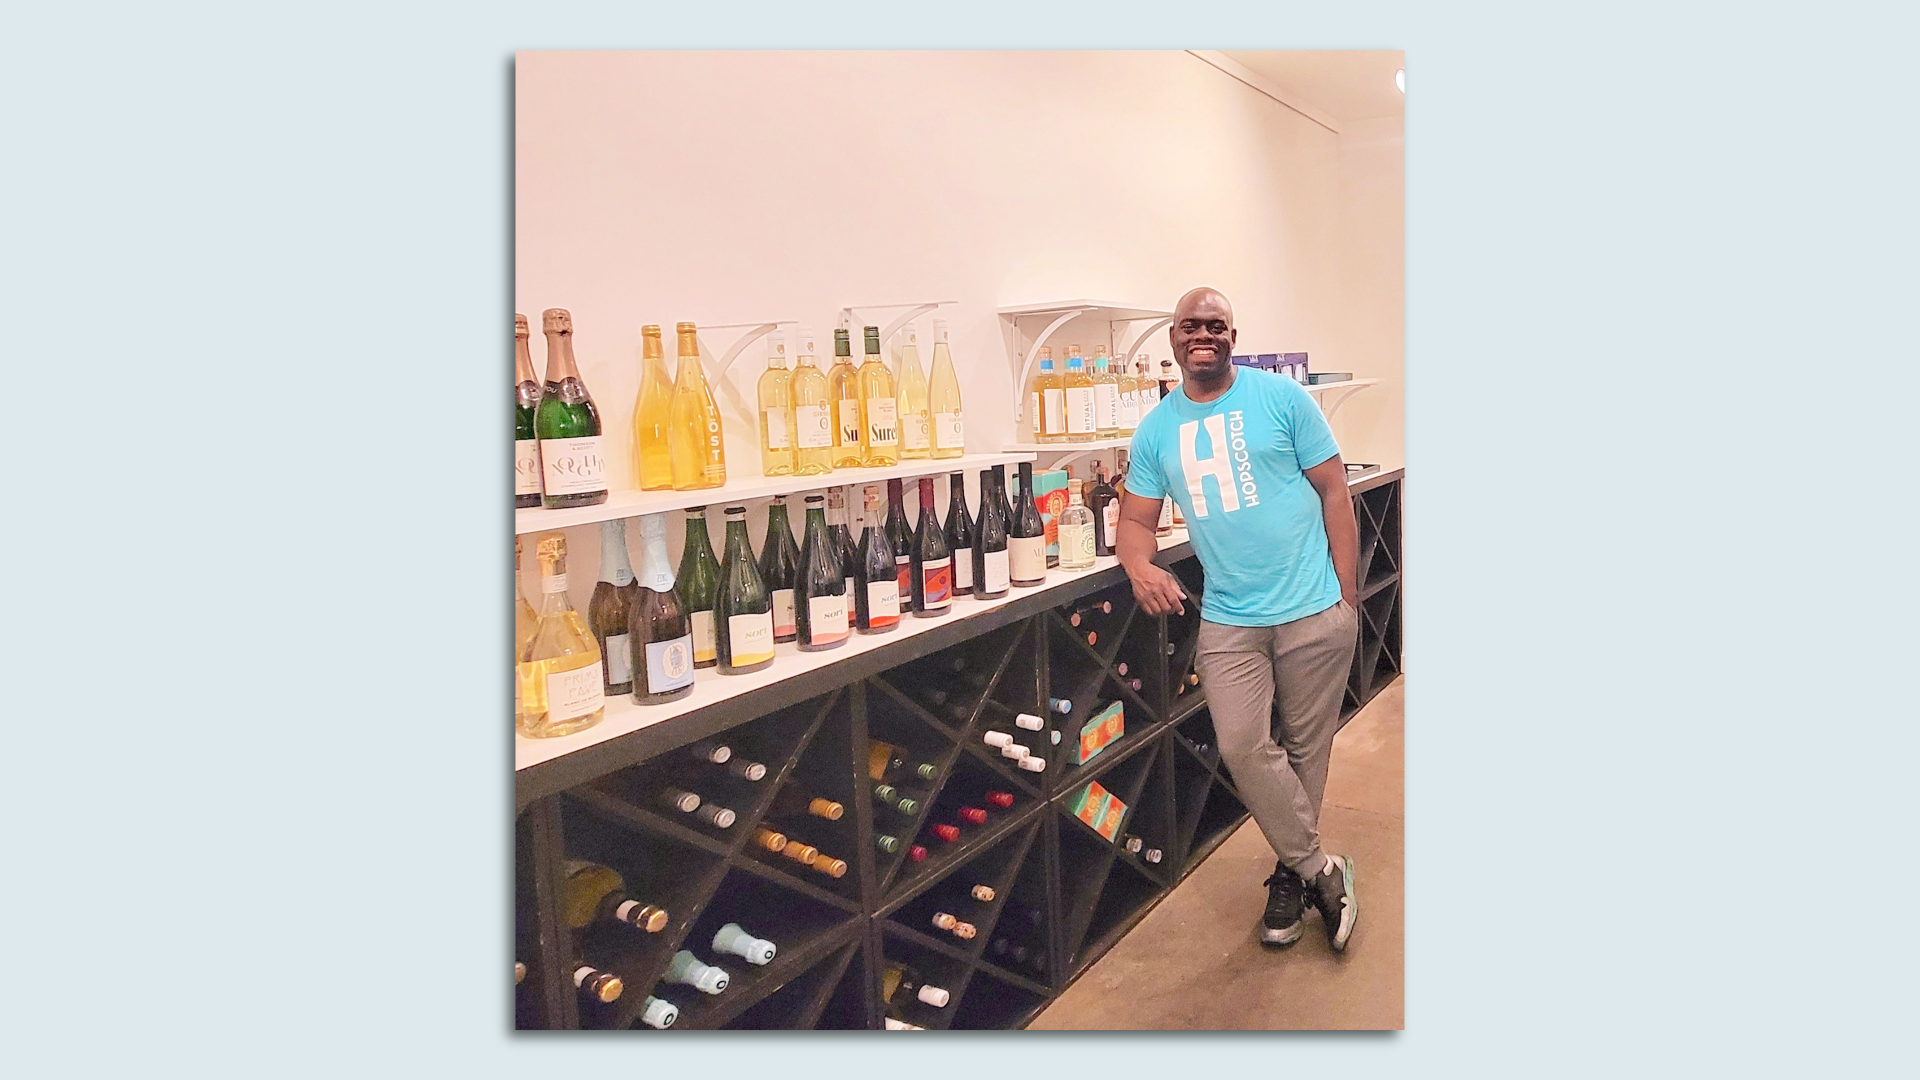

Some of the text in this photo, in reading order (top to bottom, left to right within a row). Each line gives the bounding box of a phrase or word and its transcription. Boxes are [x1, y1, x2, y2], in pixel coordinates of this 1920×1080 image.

[706, 404, 720, 462] TÖST
[1179, 413, 1240, 518] H
[1229, 410, 1260, 508] HOPSCOTCH
